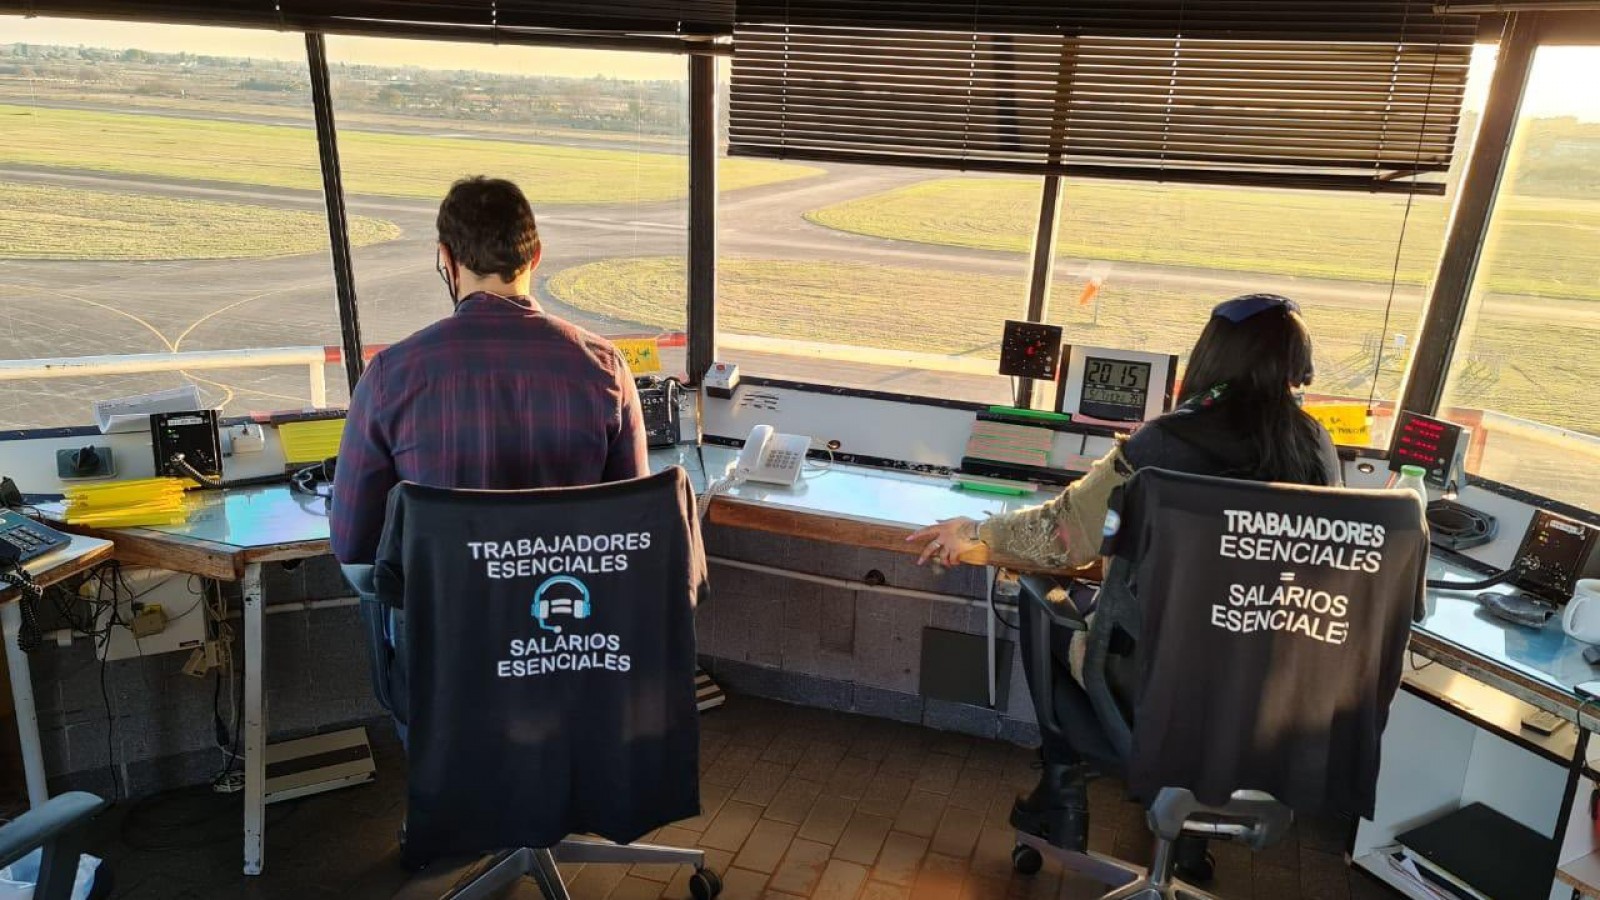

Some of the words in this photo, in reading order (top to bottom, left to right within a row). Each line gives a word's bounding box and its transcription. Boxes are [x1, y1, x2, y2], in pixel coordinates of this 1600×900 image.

[1223, 509, 1385, 547] TRABAJADORES
[468, 532, 650, 559] TRABAJADORES
[1220, 535, 1382, 573] ESENCIALES
[487, 554, 628, 578] ESENCIALES
[1228, 584, 1349, 617] SALARIOS
[510, 633, 620, 657] SALARIOS
[497, 653, 631, 677] ESENCIALES
